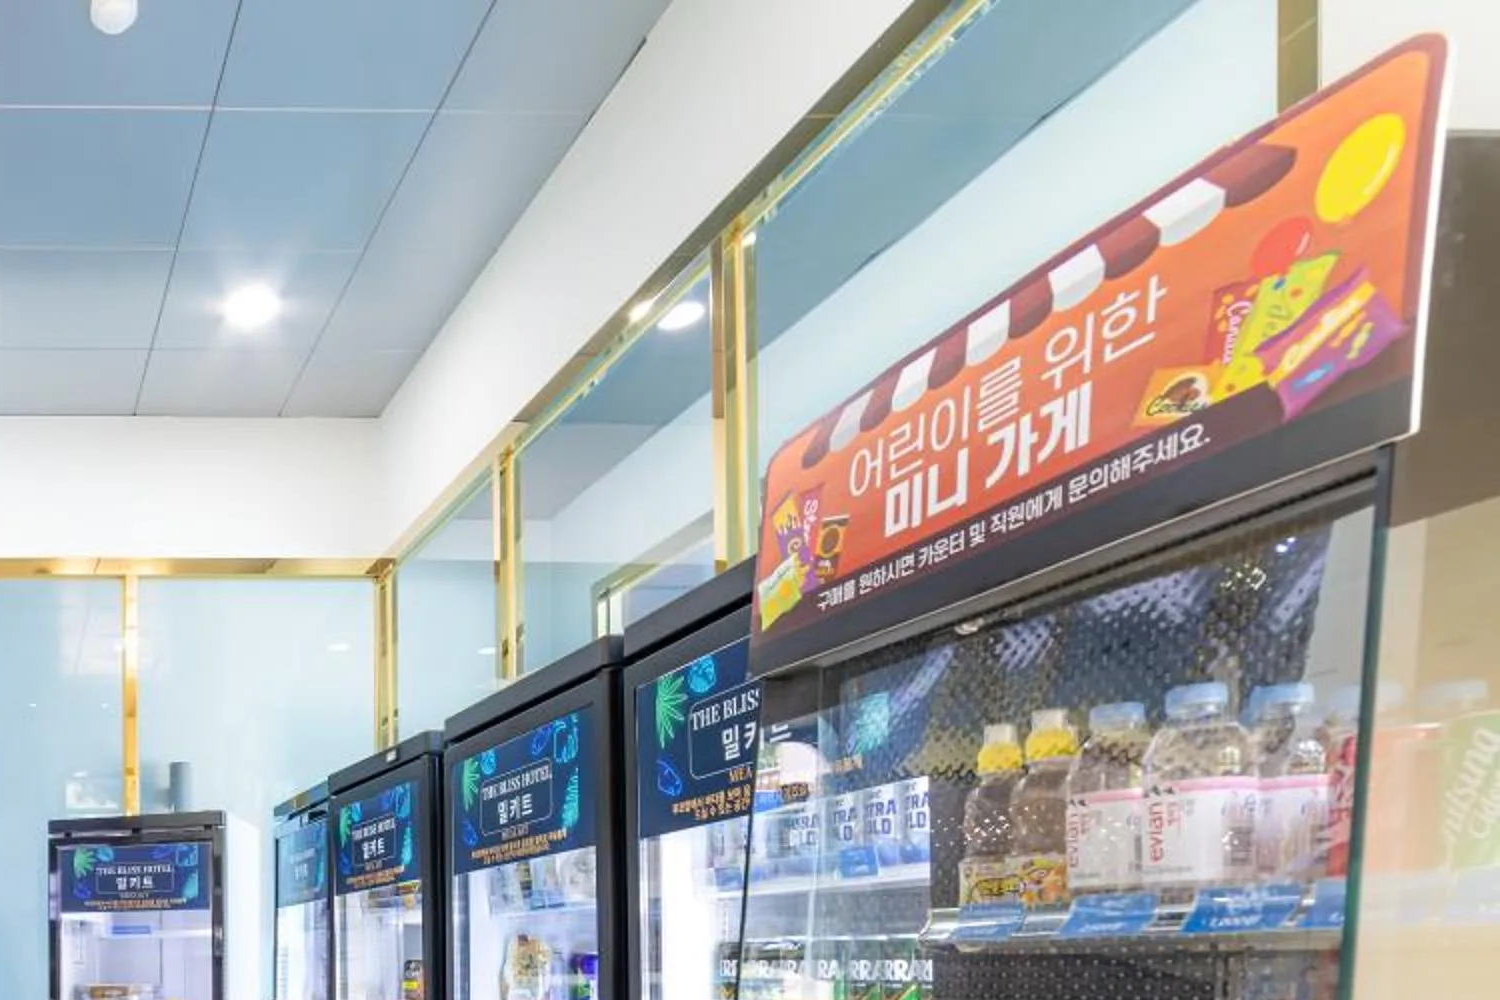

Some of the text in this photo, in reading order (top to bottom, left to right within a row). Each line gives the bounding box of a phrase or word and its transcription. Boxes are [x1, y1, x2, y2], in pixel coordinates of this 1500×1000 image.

[850, 356, 1022, 497] 어린이를
[1041, 275, 1167, 391] 위한
[884, 449, 968, 537] 미니
[986, 381, 1092, 488] 가게
[816, 422, 1211, 612] 구매를 원하시면 카운터 및 직원에게 문의해주세요.
[690, 705, 721, 731] THE
[497, 792, 533, 825] 밀키트
[1149, 801, 1164, 864] evian
